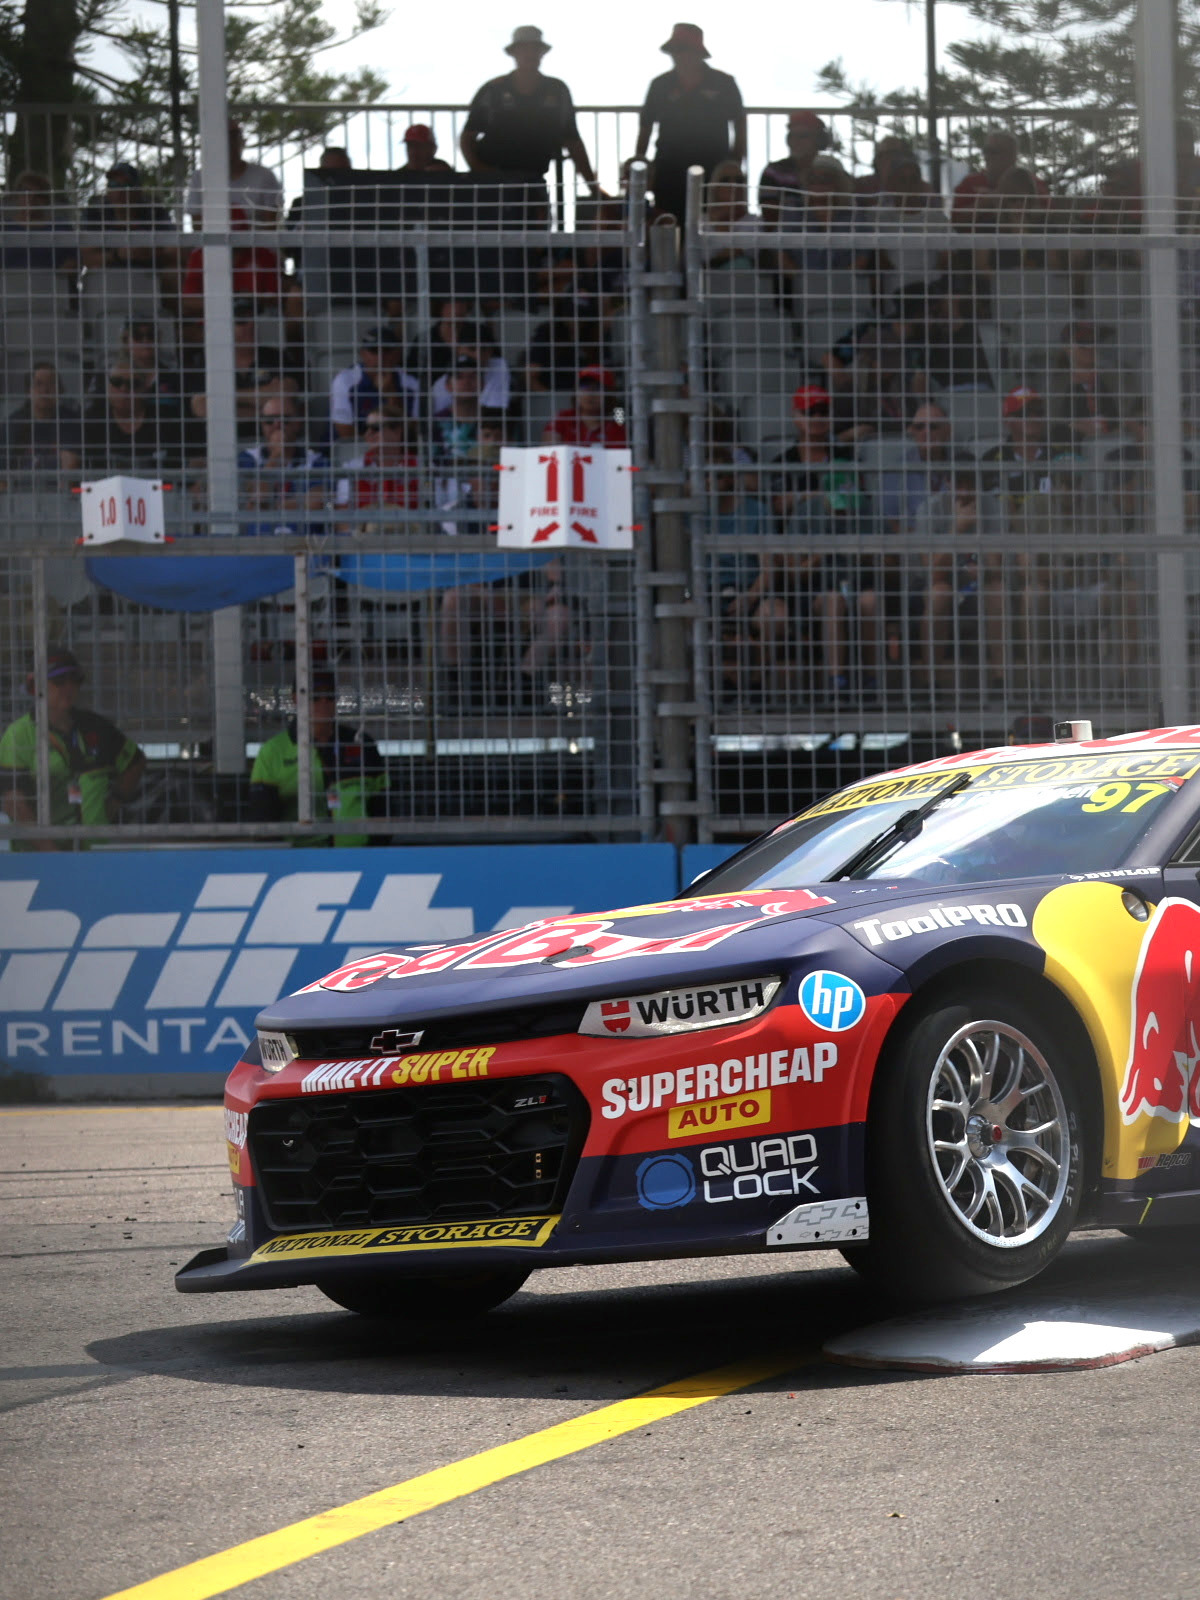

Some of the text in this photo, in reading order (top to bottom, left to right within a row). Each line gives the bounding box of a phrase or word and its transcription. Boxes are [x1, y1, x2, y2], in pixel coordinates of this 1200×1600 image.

[100, 496, 117, 527] 1.0
[125, 496, 147, 526] 1.0
[530, 506, 559, 517] FIRE
[570, 506, 598, 518] FIRE
[979, 753, 1200, 788] STORAGE
[1081, 781, 1173, 814] 97
[1086, 866, 1160, 880] DUNLOP
[0, 871, 574, 1012] hrift
[854, 904, 1028, 946] ToolPRO
[636, 982, 765, 1025] WÜRTH
[811, 972, 854, 1031] hp
[6, 1018, 254, 1058] RENTA
[301, 1047, 497, 1093] MAKE IT SUPER
[601, 1042, 838, 1119] SUPERCHEAP
[514, 1095, 547, 1108] ZL1
[677, 1099, 760, 1130] AUTO
[699, 1133, 818, 1177] QUAD
[1155, 1152, 1192, 1169] Repco
[703, 1166, 821, 1204] LOCK
[260, 1231, 372, 1255] NATIONAL
[379, 1219, 538, 1246] STORAGE
